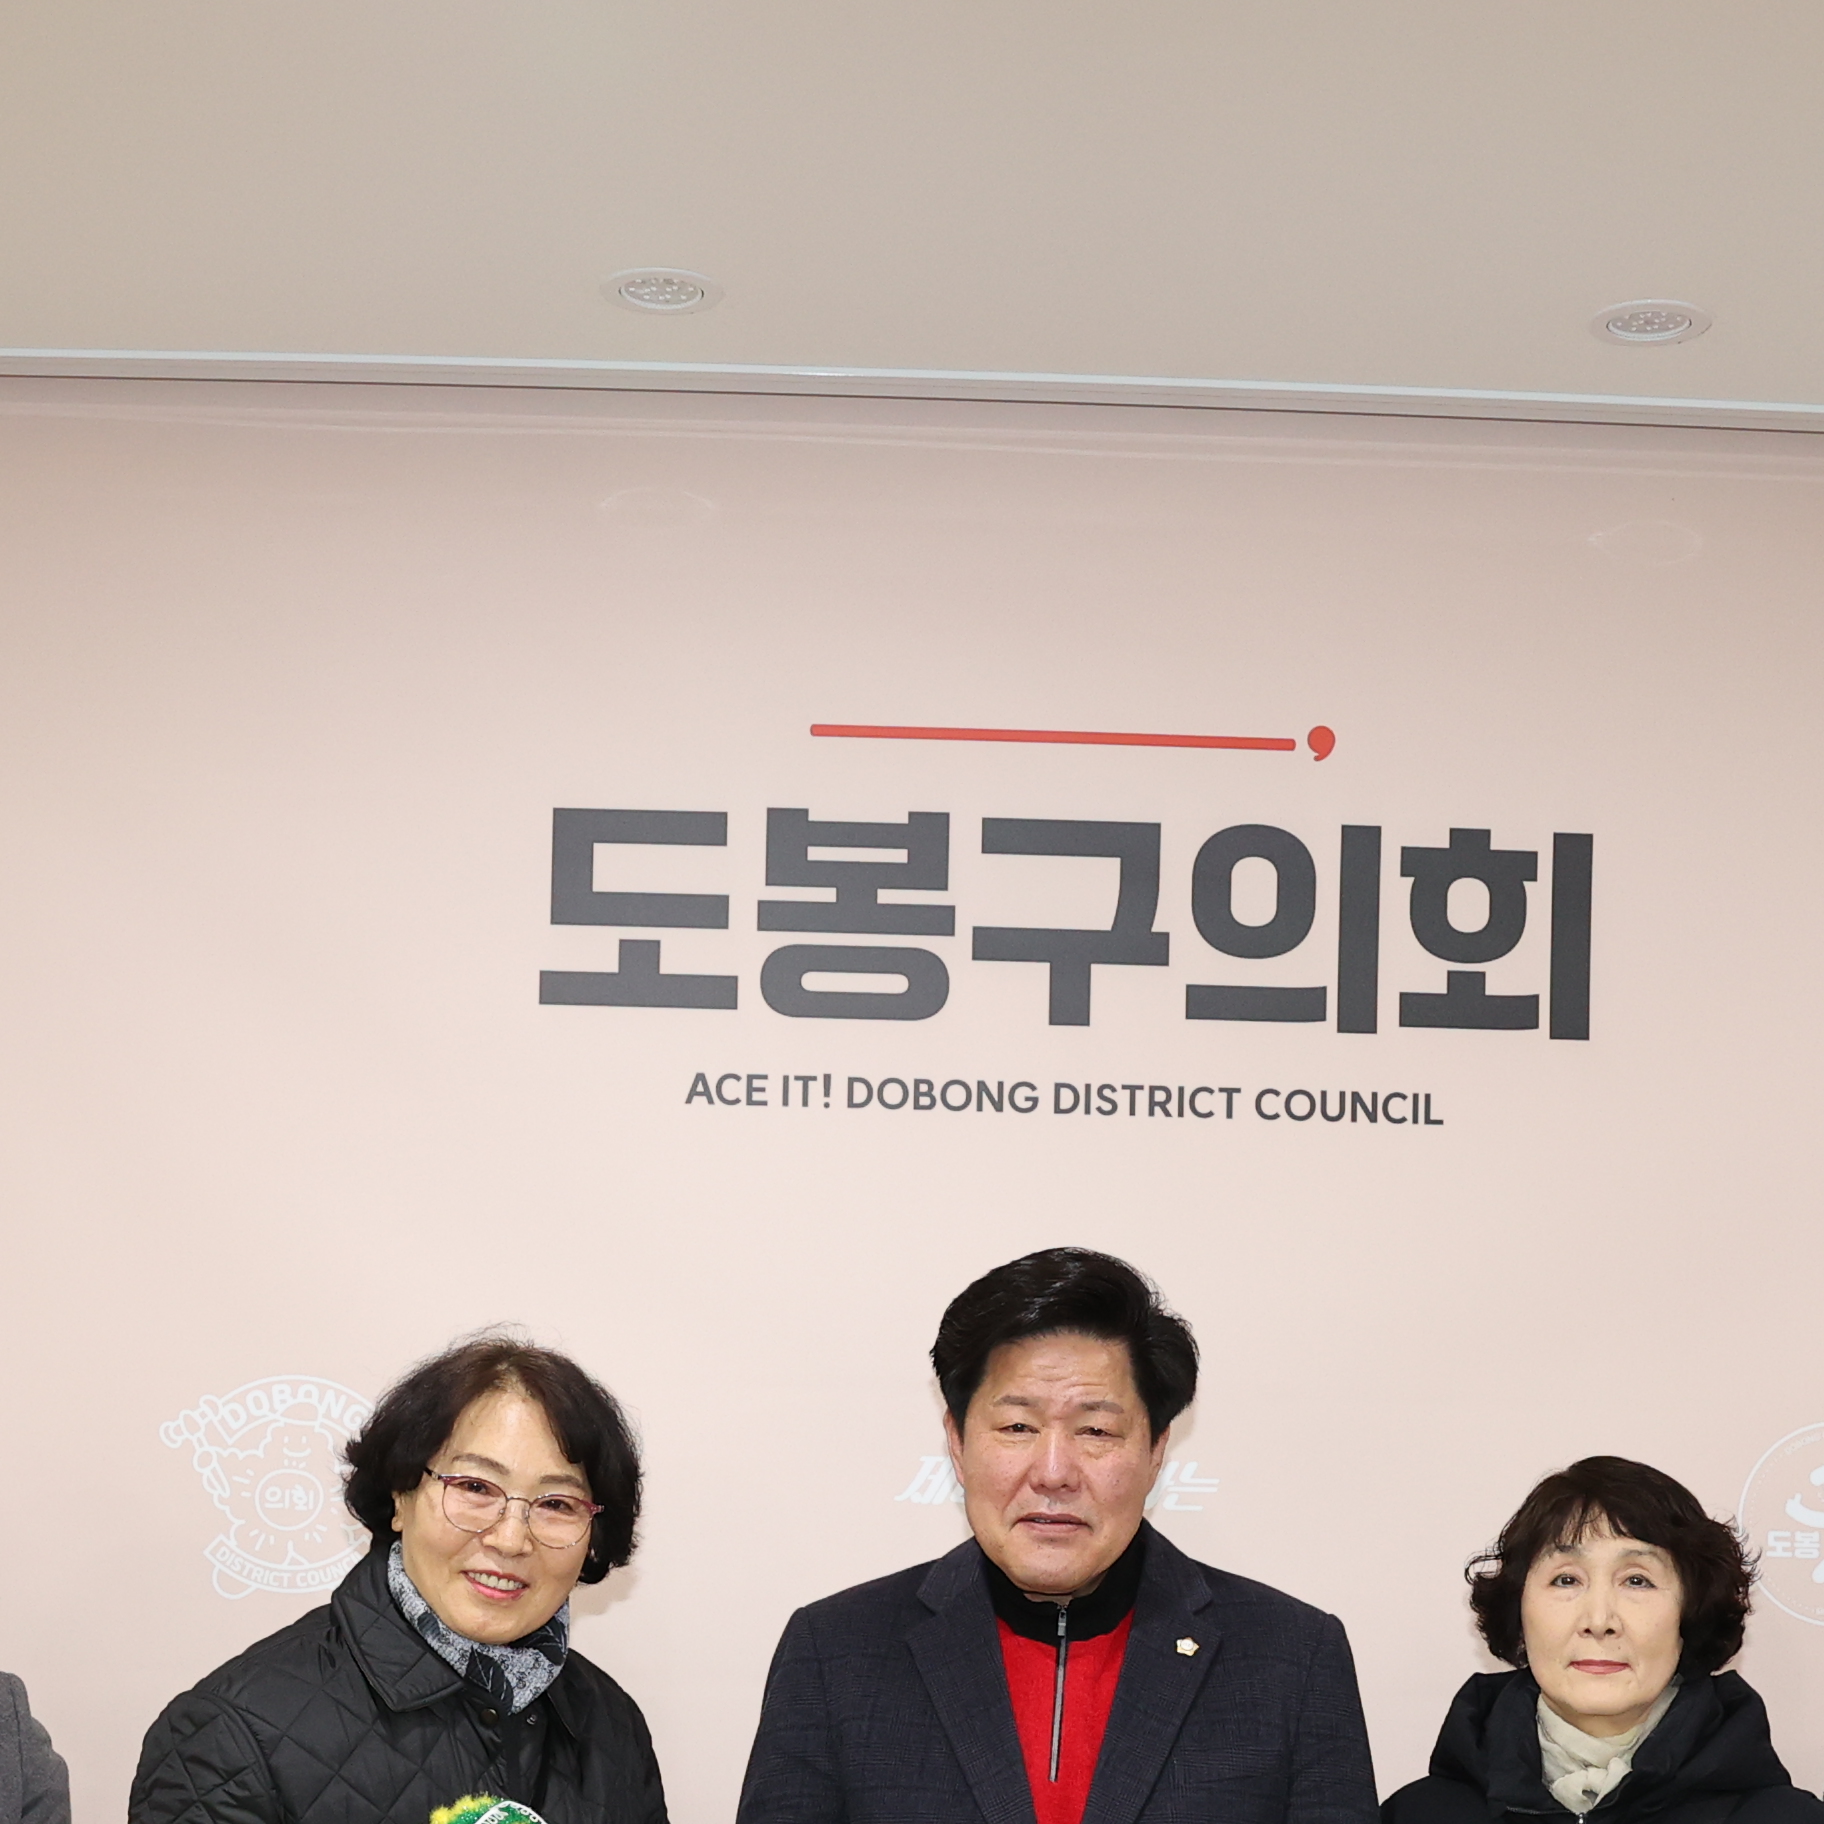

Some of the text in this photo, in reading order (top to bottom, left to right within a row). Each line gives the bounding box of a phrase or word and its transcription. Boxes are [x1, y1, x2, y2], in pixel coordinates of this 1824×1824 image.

[539, 808, 1593, 1041] 도봉구의회
[686, 1073, 1443, 1125] ACE IT! DOBONG DISTRICT COUNCIL
[222, 1384, 369, 1430] DOBONG
[264, 1484, 314, 1511] 의회
[216, 1547, 292, 1588] DISTRICT
